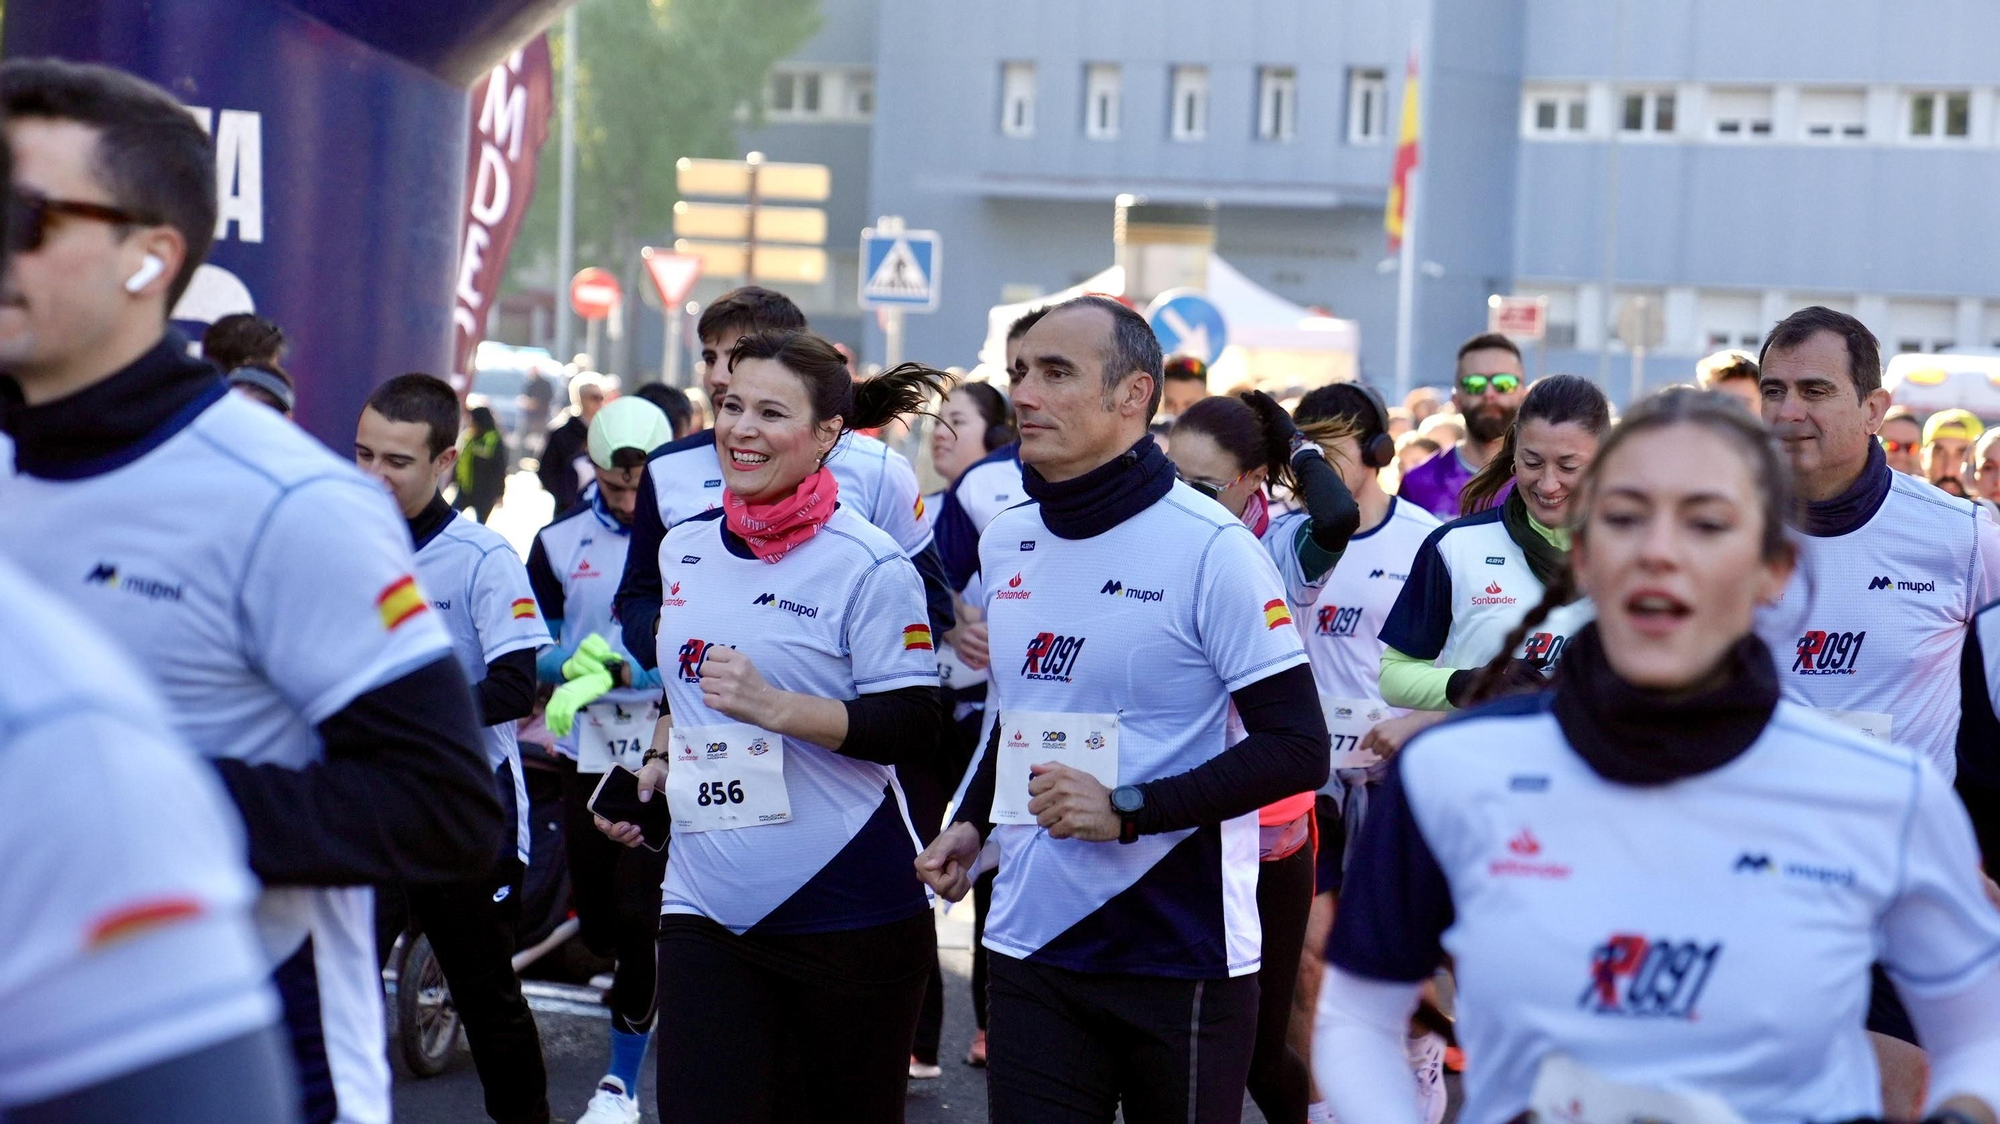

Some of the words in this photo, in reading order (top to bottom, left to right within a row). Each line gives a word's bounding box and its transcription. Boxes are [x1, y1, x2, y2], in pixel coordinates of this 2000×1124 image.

[996, 589, 1031, 600] Santander
[1125, 587, 1164, 603] mupol
[1897, 580, 1935, 594] mupol
[779, 599, 819, 619] mupol
[1471, 596, 1517, 605] Santander
[1315, 605, 1363, 634] R091
[1021, 632, 1086, 676] R091
[1792, 630, 1867, 672] R091
[1026, 673, 1071, 683] SOLIDARIA
[1799, 668, 1855, 676] SOLIDARIA
[607, 737, 641, 756] 174
[1007, 740, 1030, 748] Santander
[1328, 733, 1359, 752] 77
[697, 779, 745, 806] 856
